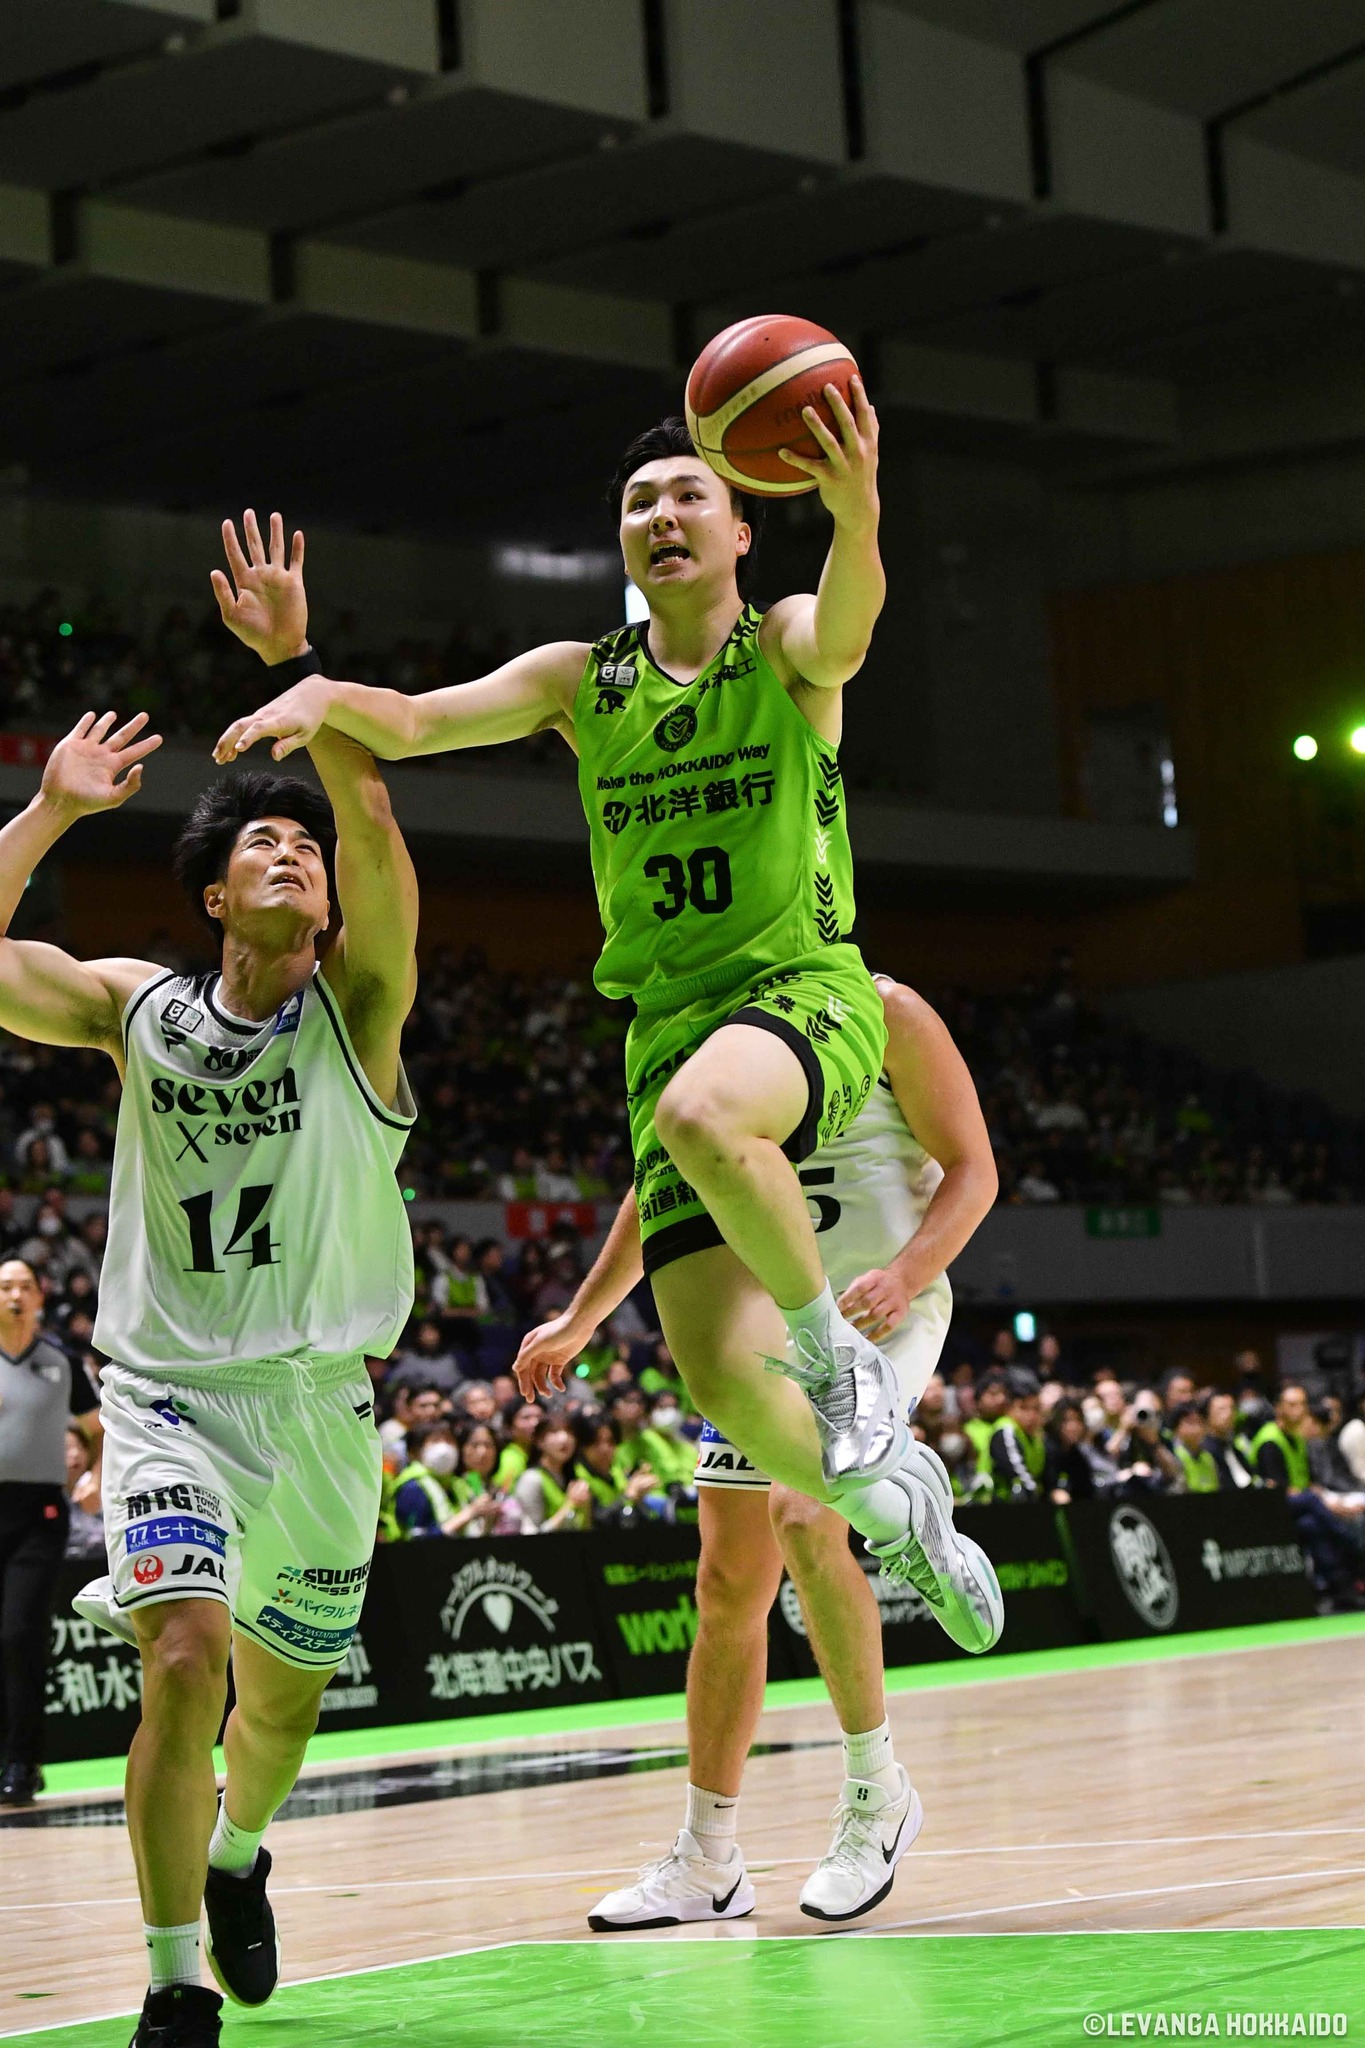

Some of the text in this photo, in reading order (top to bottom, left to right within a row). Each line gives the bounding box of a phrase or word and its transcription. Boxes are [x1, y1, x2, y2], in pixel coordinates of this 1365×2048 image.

[629, 771, 655, 786] the
[656, 752, 735, 781] HOKKAIDO
[737, 744, 770, 762] Way
[634, 770, 776, 826] 北洋銀行
[643, 845, 733, 922] 30
[151, 1067, 302, 1117] seven
[214, 1108, 303, 1145] seven
[178, 1183, 281, 1273] 14
[701, 1451, 755, 1471] JAL
[126, 1484, 193, 1520] MTG
[194, 1495, 222, 1518] TOYOTA
[197, 1504, 217, 1522] Group
[129, 1525, 149, 1543] 77
[130, 1540, 149, 1551] BANK
[142, 1574, 158, 1583] JAL
[301, 1557, 372, 1585] SQUAR
[294, 1598, 361, 1619] バイタルネ
